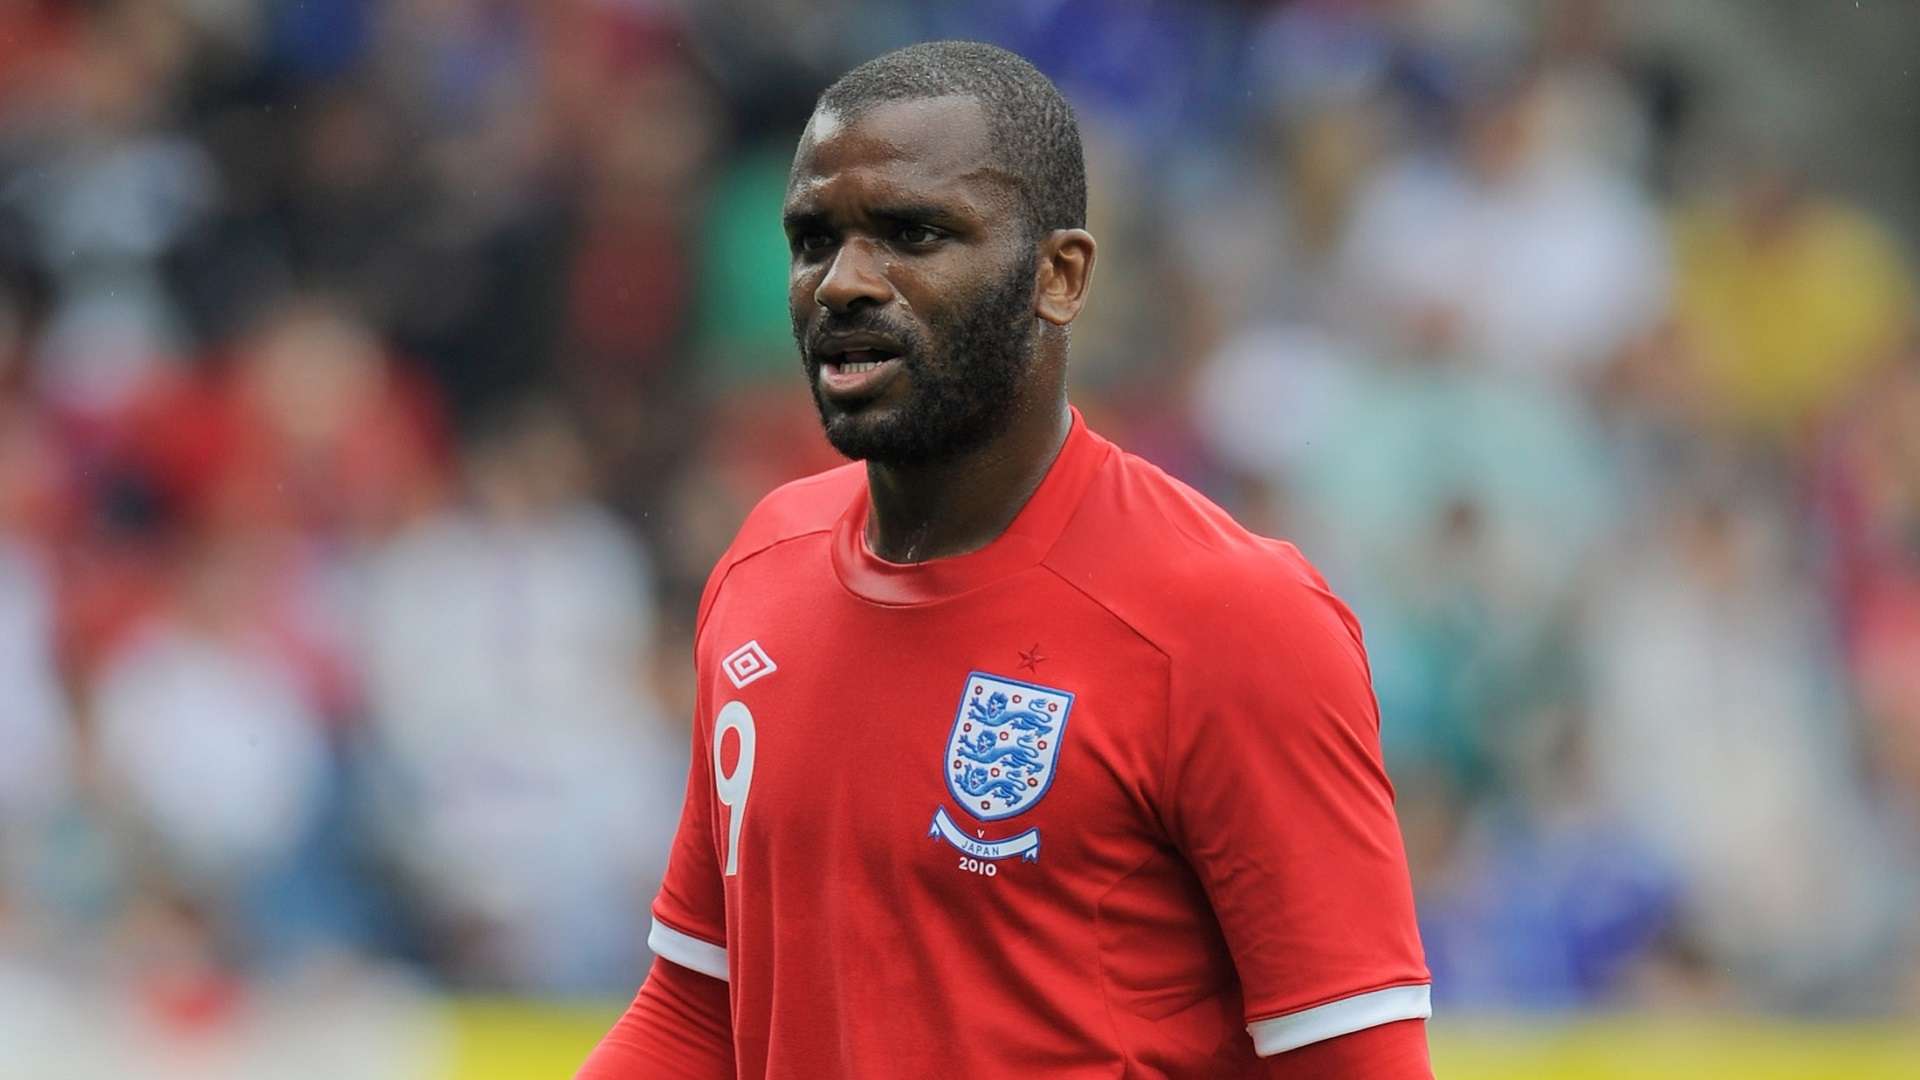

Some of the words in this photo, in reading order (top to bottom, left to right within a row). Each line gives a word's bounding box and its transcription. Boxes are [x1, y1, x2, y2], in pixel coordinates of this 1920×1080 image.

[713, 700, 756, 876] 9
[961, 841, 1000, 856] JAPAN
[959, 857, 997, 877] 2010
